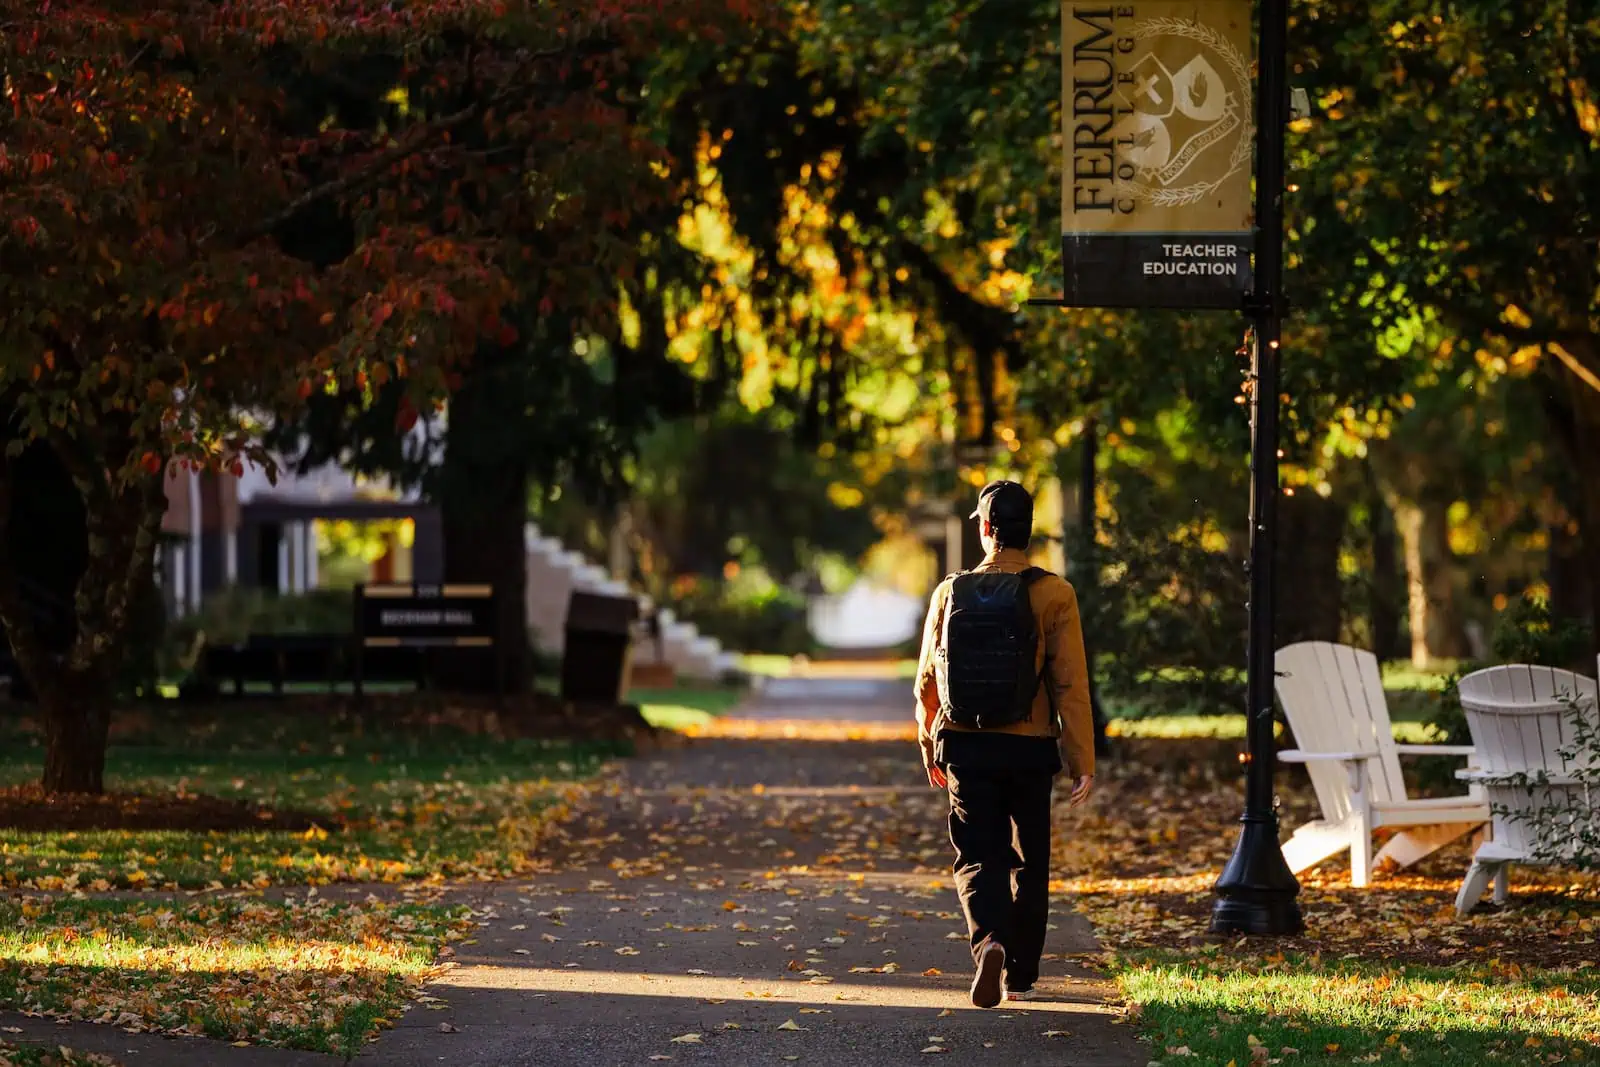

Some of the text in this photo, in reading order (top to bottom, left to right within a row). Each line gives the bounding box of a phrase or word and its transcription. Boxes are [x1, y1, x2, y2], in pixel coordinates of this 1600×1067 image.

[1073, 6, 1115, 215] FERRUM
[1117, 5, 1136, 215] COLLEGE
[1163, 158, 1182, 179] NON
[1162, 244, 1238, 258] TEACHER
[1143, 262, 1238, 276] EDUCATION
